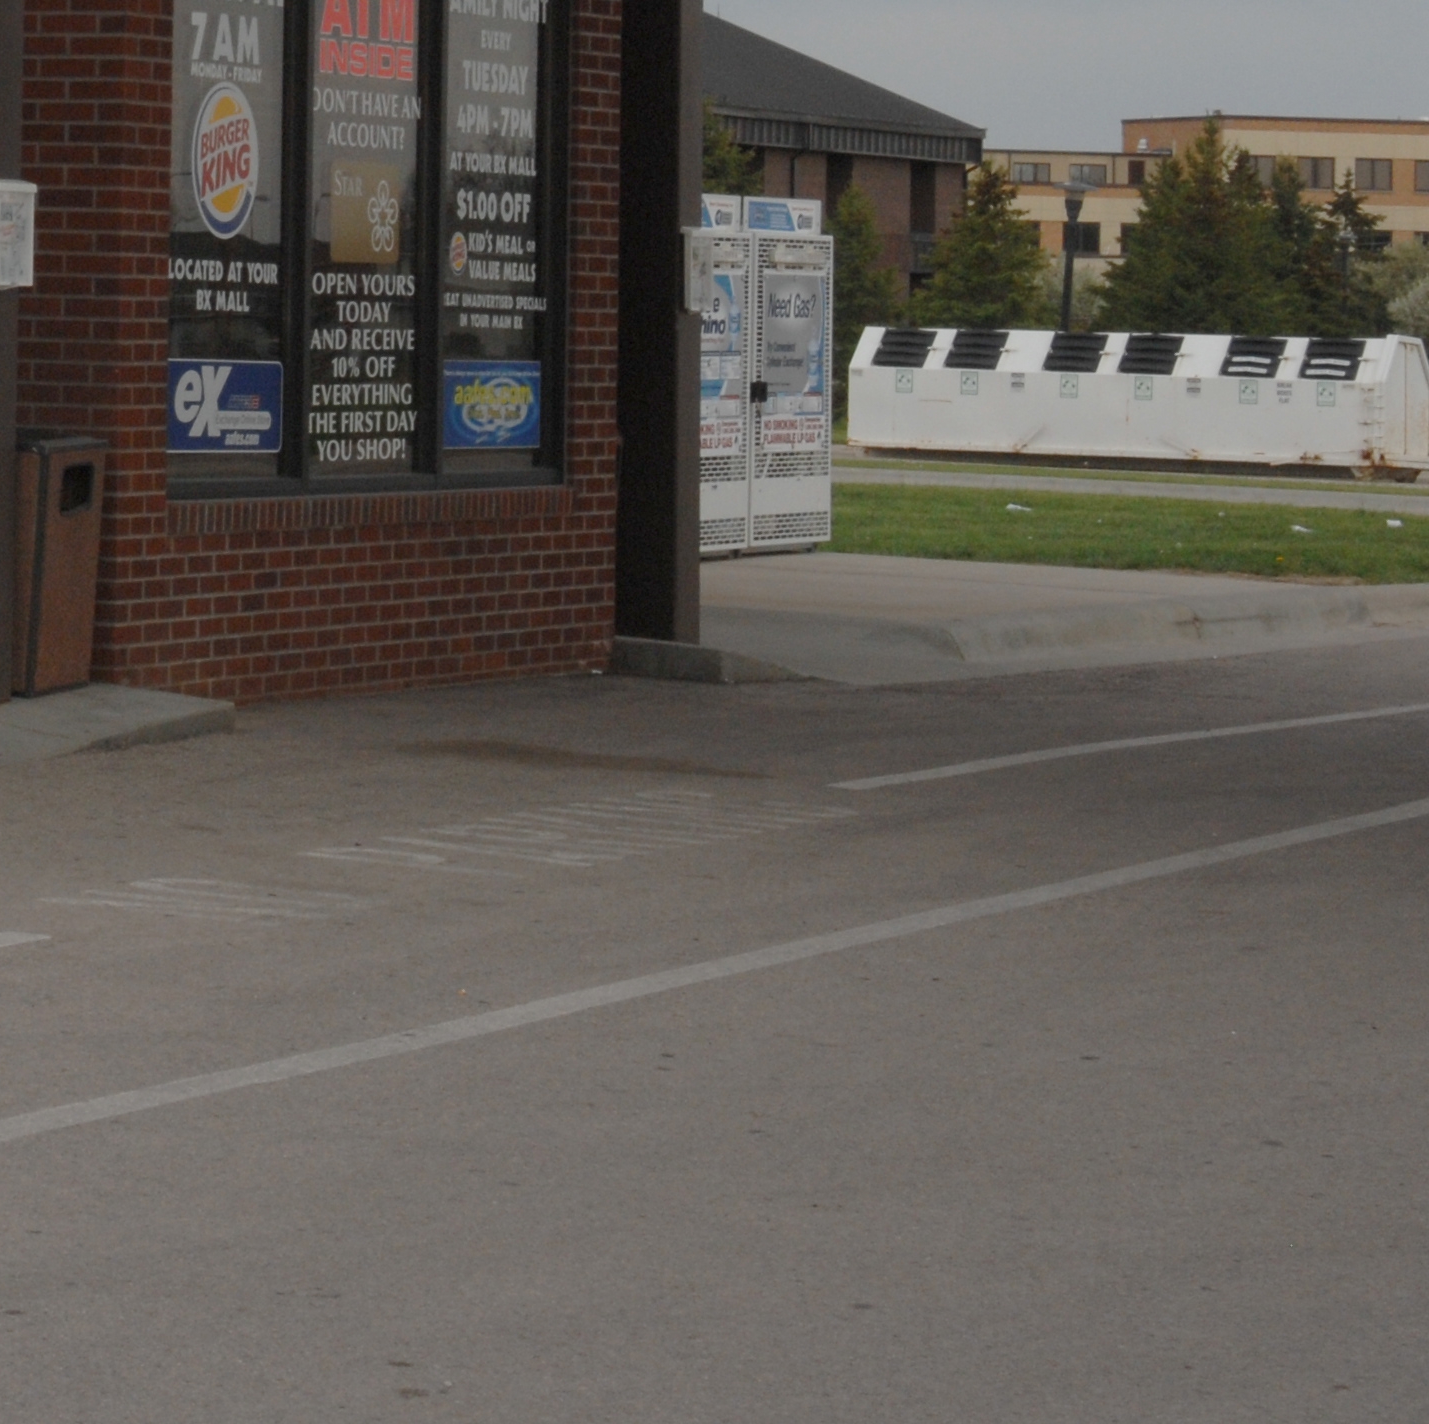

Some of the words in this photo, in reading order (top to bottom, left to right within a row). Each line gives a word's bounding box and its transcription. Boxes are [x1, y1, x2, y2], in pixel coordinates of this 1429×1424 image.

[191, 11, 208, 60] 7
[213, 13, 260, 65] AM
[481, 29, 512, 51] EVERY
[319, 37, 414, 81] INSIDE
[463, 60, 529, 95] TUESDAY
[313, 87, 358, 113] DON'T
[362, 92, 398, 117] HAVE
[402, 97, 422, 119] AN
[457, 104, 489, 134] 4PM
[501, 107, 533, 139] 7PM
[201, 119, 250, 159] BURGER
[327, 122, 405, 150] ACCOUNT?
[201, 144, 251, 199] KING
[457, 188, 497, 221] $1.00
[501, 192, 531, 223] OFF
[495, 235, 524, 255] MEAL
[168, 258, 224, 282] LOCATED
[227, 261, 243, 282] AT
[247, 262, 279, 285] YOUR
[468, 260, 501, 281] VALUE
[503, 262, 537, 283] MEALS
[312, 272, 358, 295] OPEN
[362, 275, 416, 297] YOURS
[196, 289, 212, 310] BX
[216, 290, 250, 312] MALL
[336, 300, 392, 323] TODAY
[768, 293, 792, 318] Need
[794, 293, 817, 318] Gas?
[701, 316, 726, 334] hino
[310, 328, 348, 350] AND
[351, 328, 416, 351] RECEIVE
[331, 356, 361, 378] 10%
[365, 356, 396, 377] OFF
[311, 383, 413, 406] EVERYTHING
[308, 412, 337, 434] THE
[341, 412, 383, 434] FIRST
[387, 410, 418, 432] DAY
[317, 440, 352, 462] YOU
[356, 439, 406, 460] SHOP!
